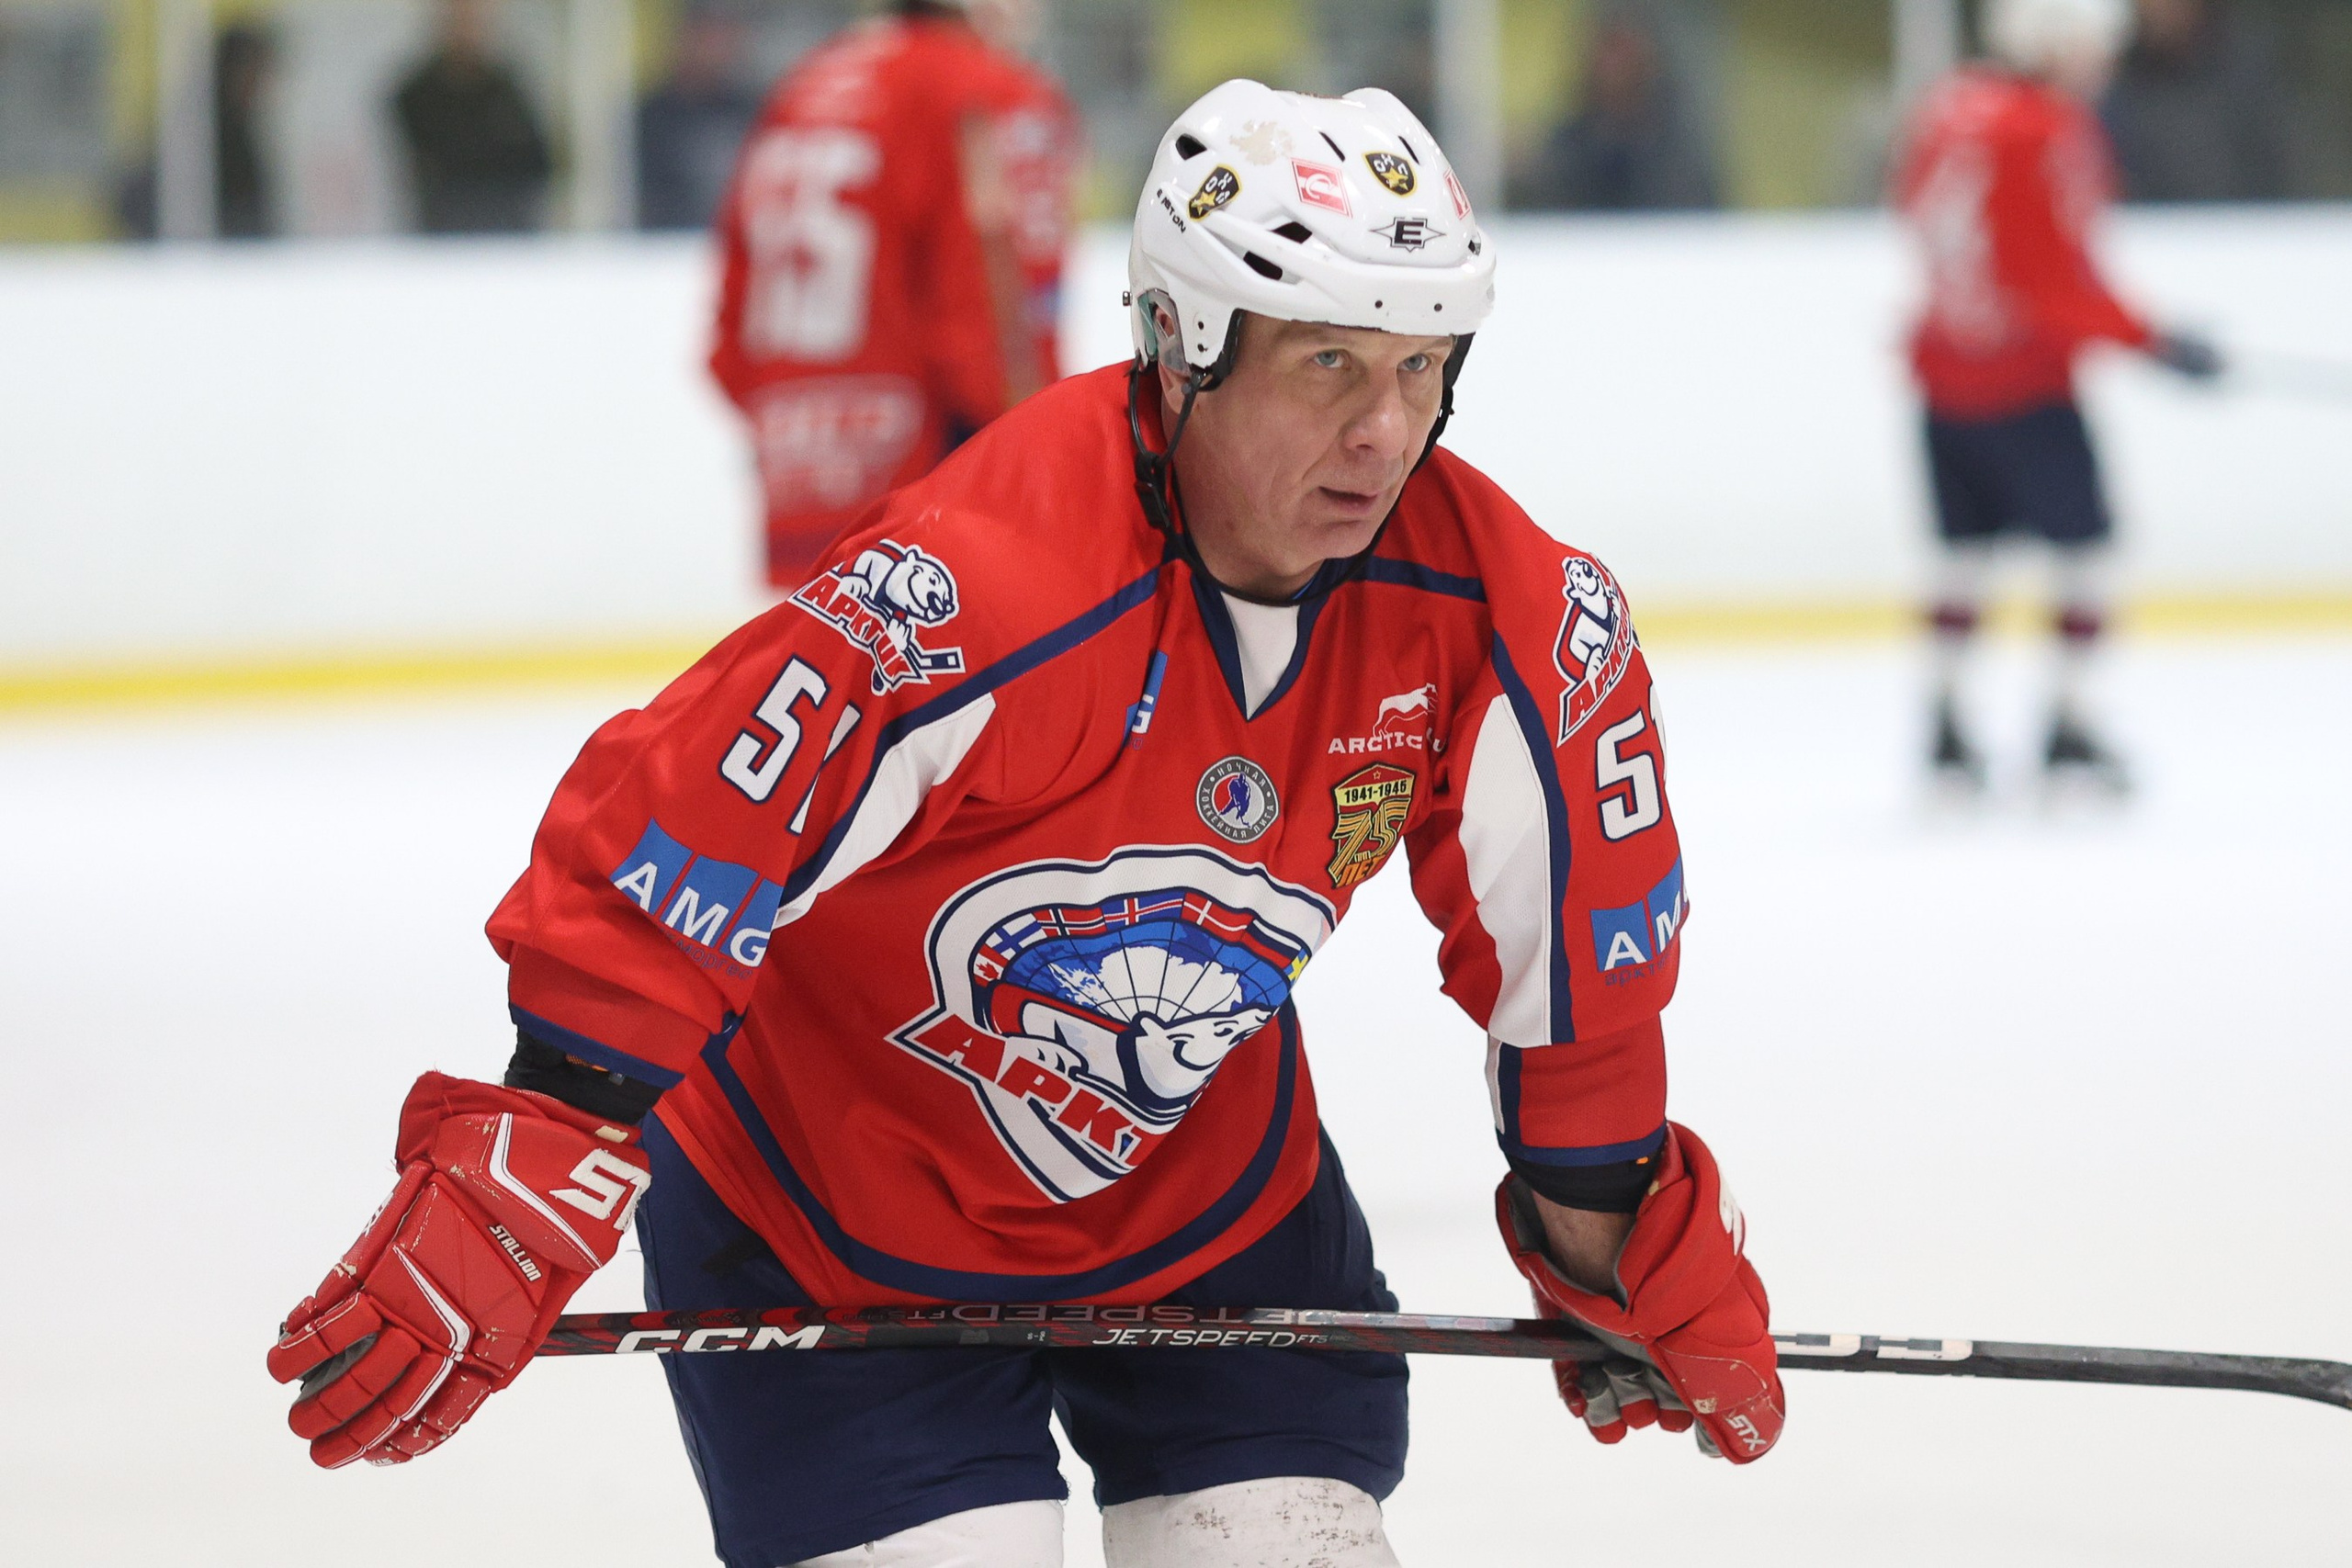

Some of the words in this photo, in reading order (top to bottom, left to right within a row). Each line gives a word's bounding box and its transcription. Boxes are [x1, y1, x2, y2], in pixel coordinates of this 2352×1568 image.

[1394, 220, 1425, 245] E
[1328, 731, 1423, 754] ARCTIC
[1216, 761, 1266, 787] НОЧНАЯ
[1343, 779, 1408, 804] 1941-1945
[1201, 787, 1247, 838] ХОККЕЙНАЯ
[1253, 805, 1274, 833] ЛИГА
[1329, 797, 1412, 884] 75
[613, 861, 771, 967] AMG
[1604, 885, 1687, 971] AM
[913, 1014, 1169, 1167] АРКТ
[489, 1224, 542, 1282] STALLION
[615, 1325, 826, 1354] CCM
[1091, 1328, 1296, 1348] JETSPEED
[1725, 1415, 1767, 1451] STX
